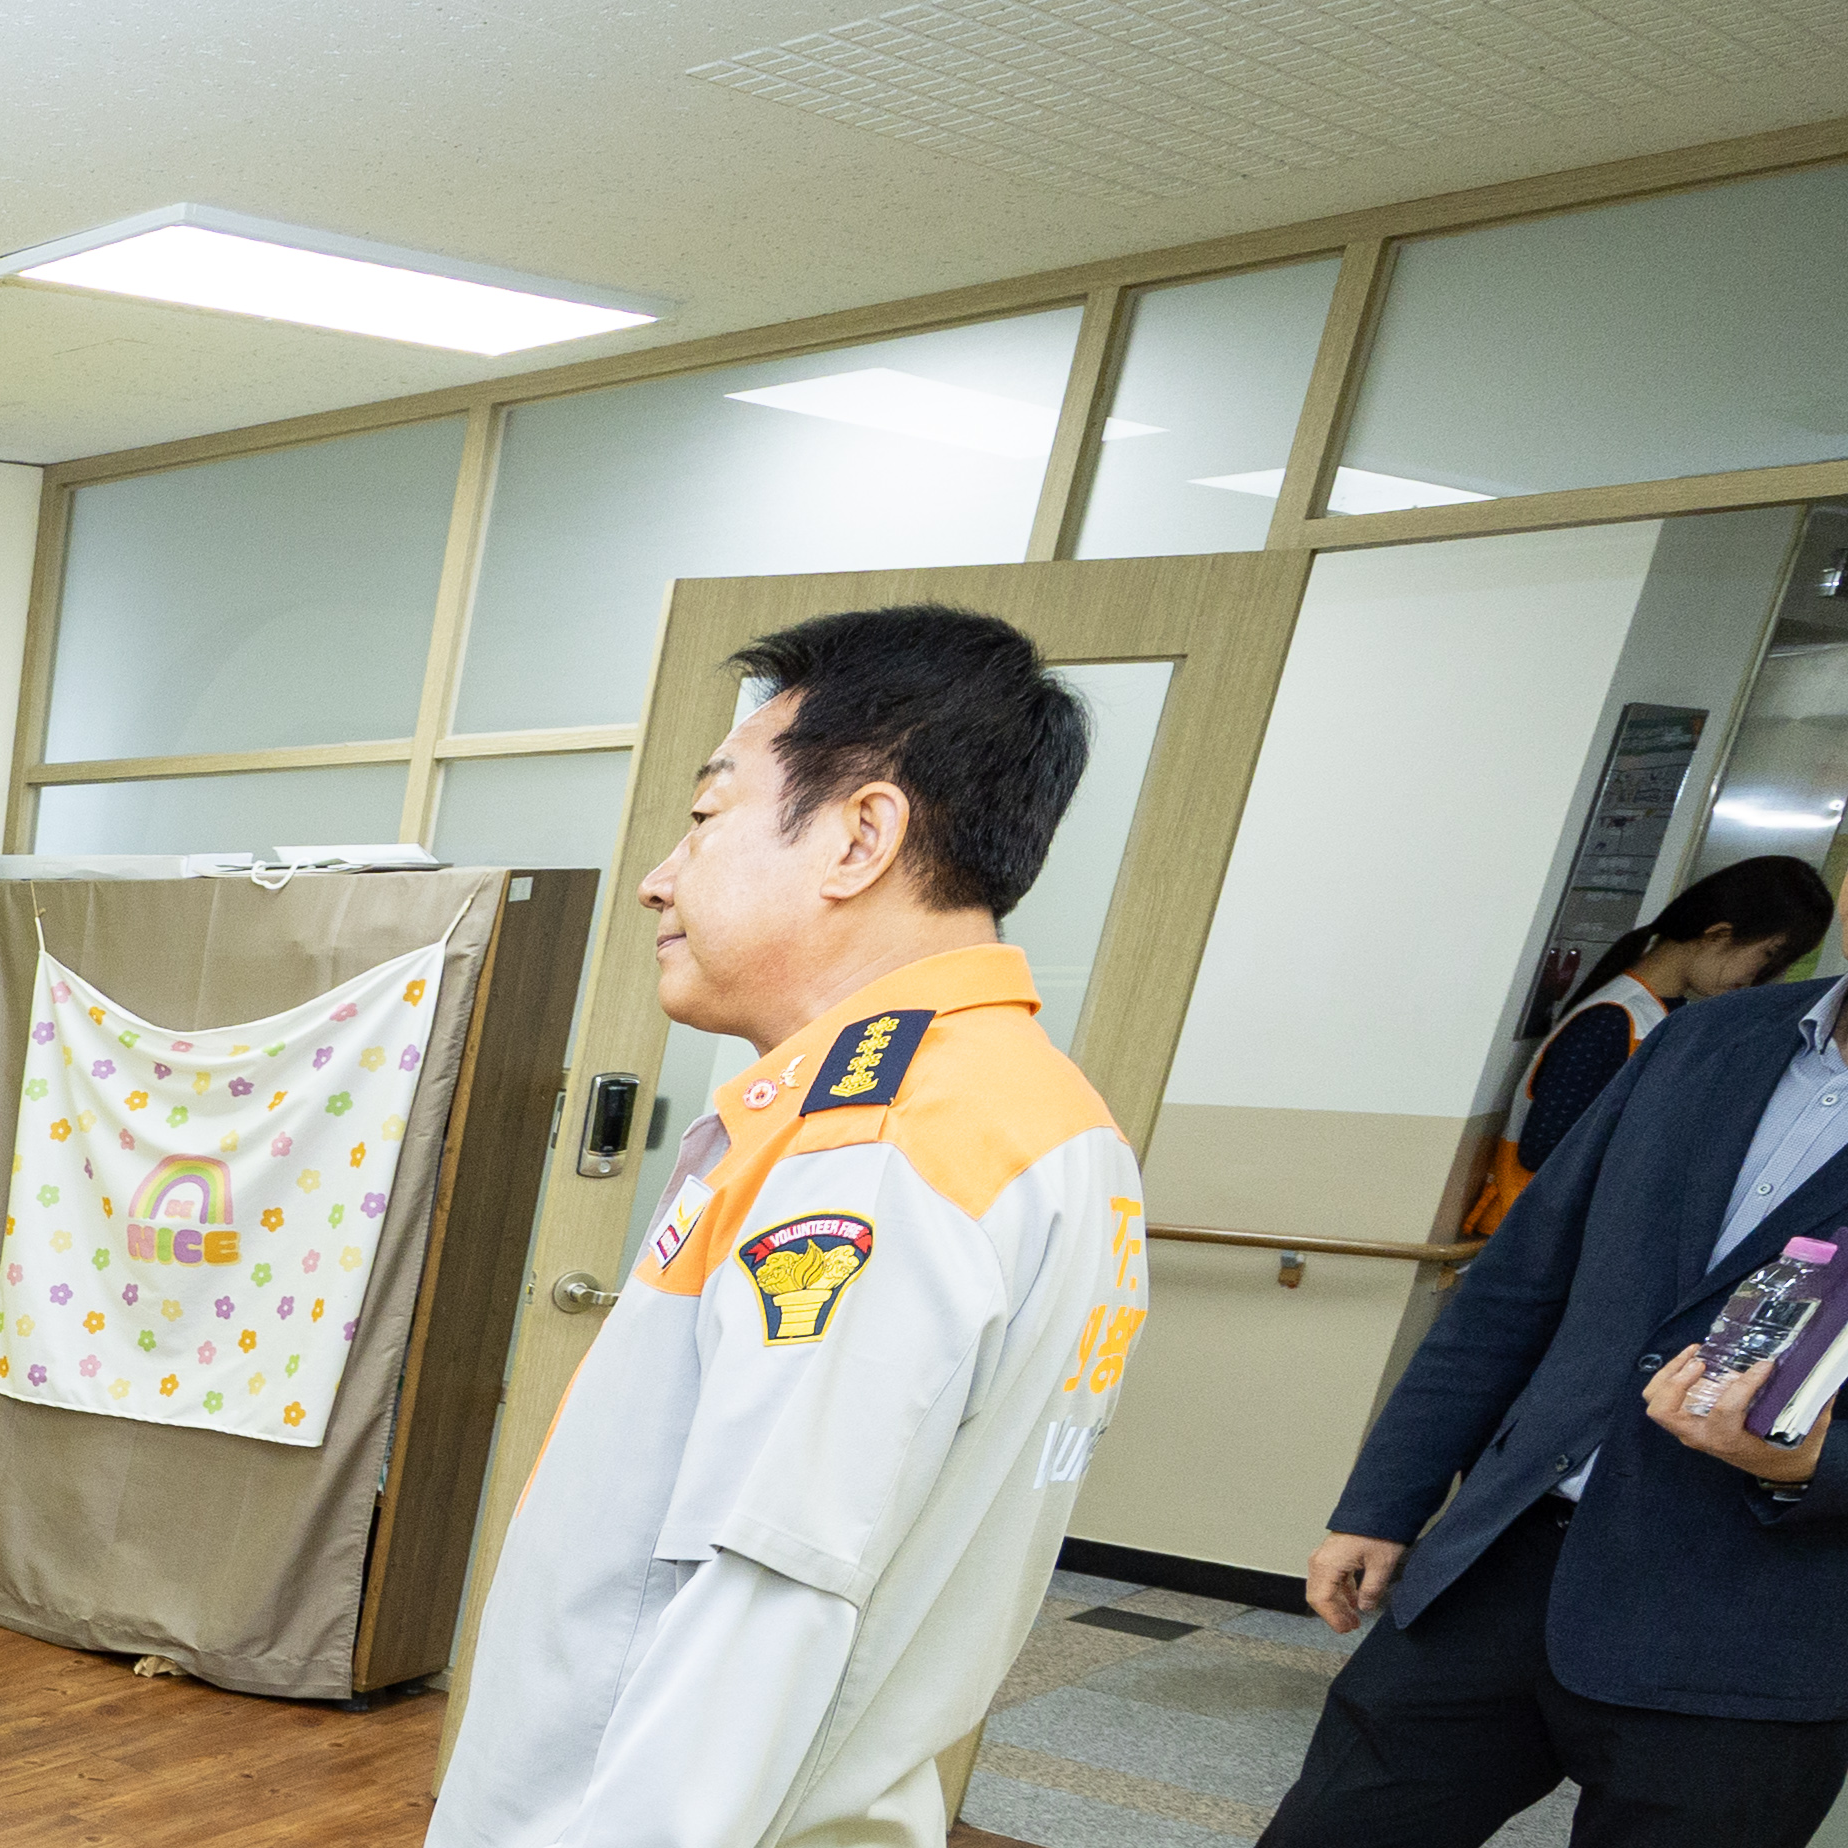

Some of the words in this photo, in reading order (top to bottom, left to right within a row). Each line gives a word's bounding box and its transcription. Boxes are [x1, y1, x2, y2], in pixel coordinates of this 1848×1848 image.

[164, 1199, 195, 1219] BE
[126, 1223, 241, 1267] NICE
[769, 1219, 839, 1247] VOLUNTEER
[838, 1219, 865, 1239] FIRE
